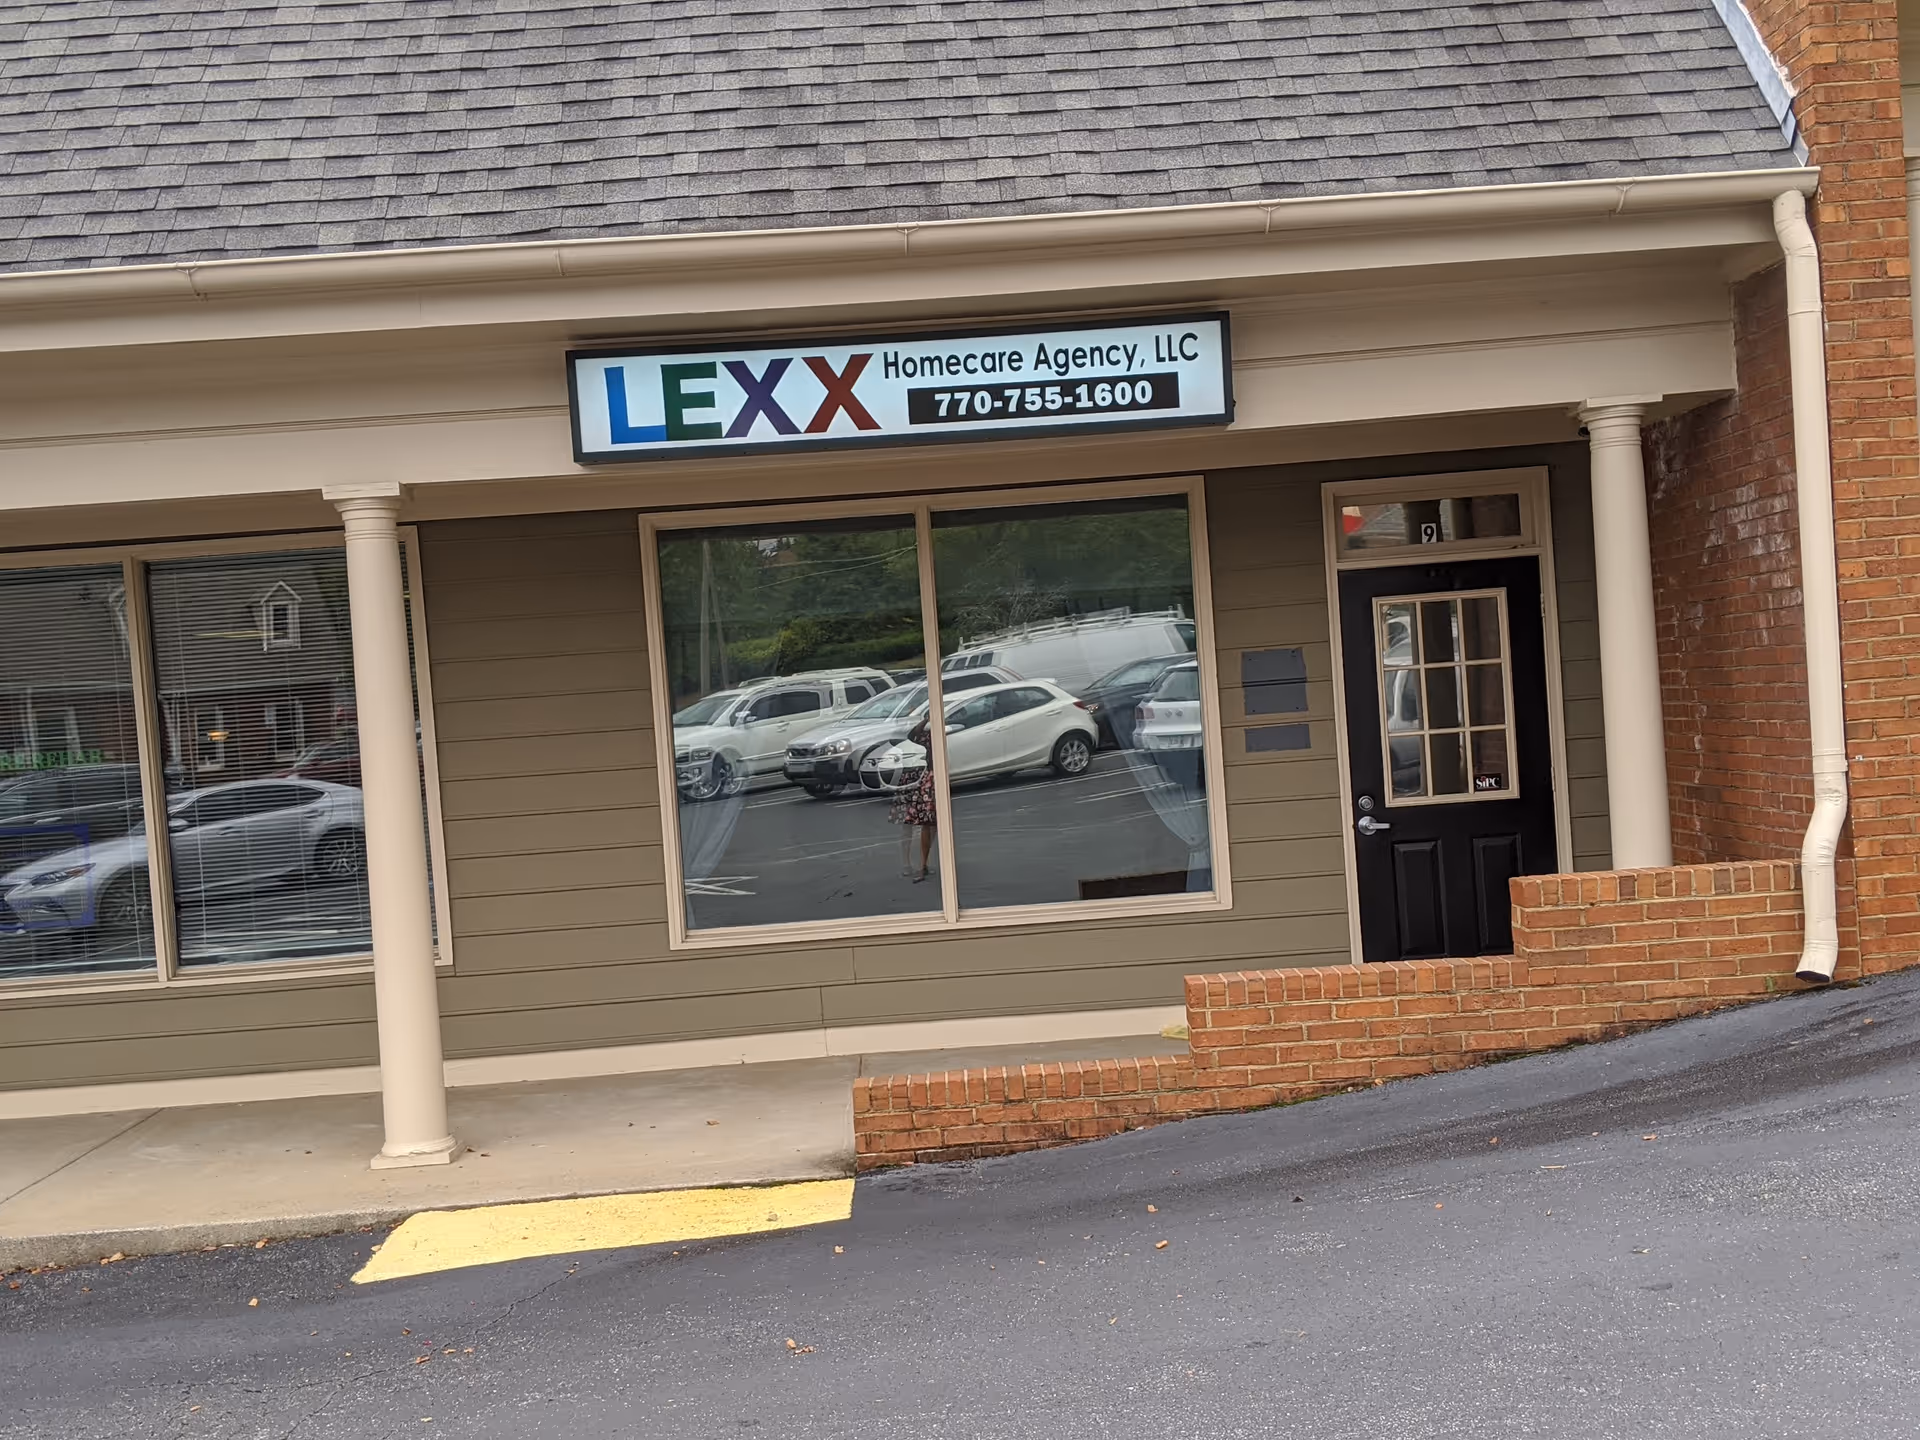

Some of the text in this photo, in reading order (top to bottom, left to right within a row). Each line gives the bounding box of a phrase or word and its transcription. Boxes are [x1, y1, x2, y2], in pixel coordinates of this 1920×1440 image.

[883, 332, 1199, 379] Homecare Agency, LLC
[604, 353, 882, 444] LEXX
[934, 380, 1152, 417] 770-755-1600
[1424, 525, 1434, 542] 9
